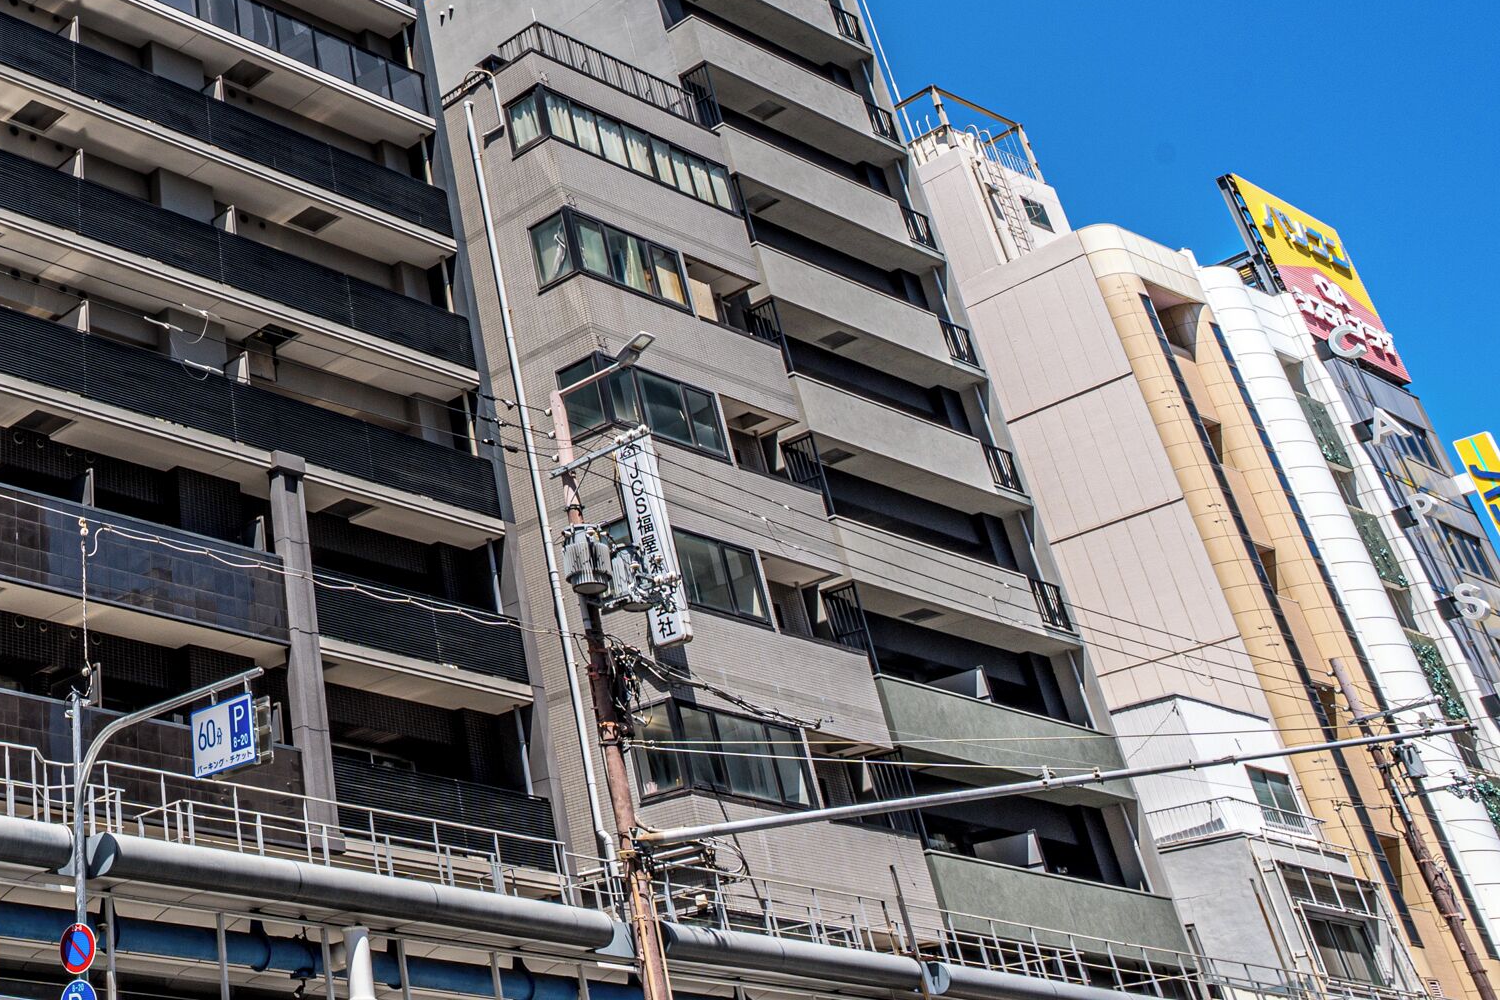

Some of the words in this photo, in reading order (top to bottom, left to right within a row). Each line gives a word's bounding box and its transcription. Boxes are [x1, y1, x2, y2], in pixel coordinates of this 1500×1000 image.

[1261, 203, 1351, 270] パソコン
[233, 705, 244, 733] P
[198, 719, 222, 751] 60分
[233, 733, 249, 748] 8-20
